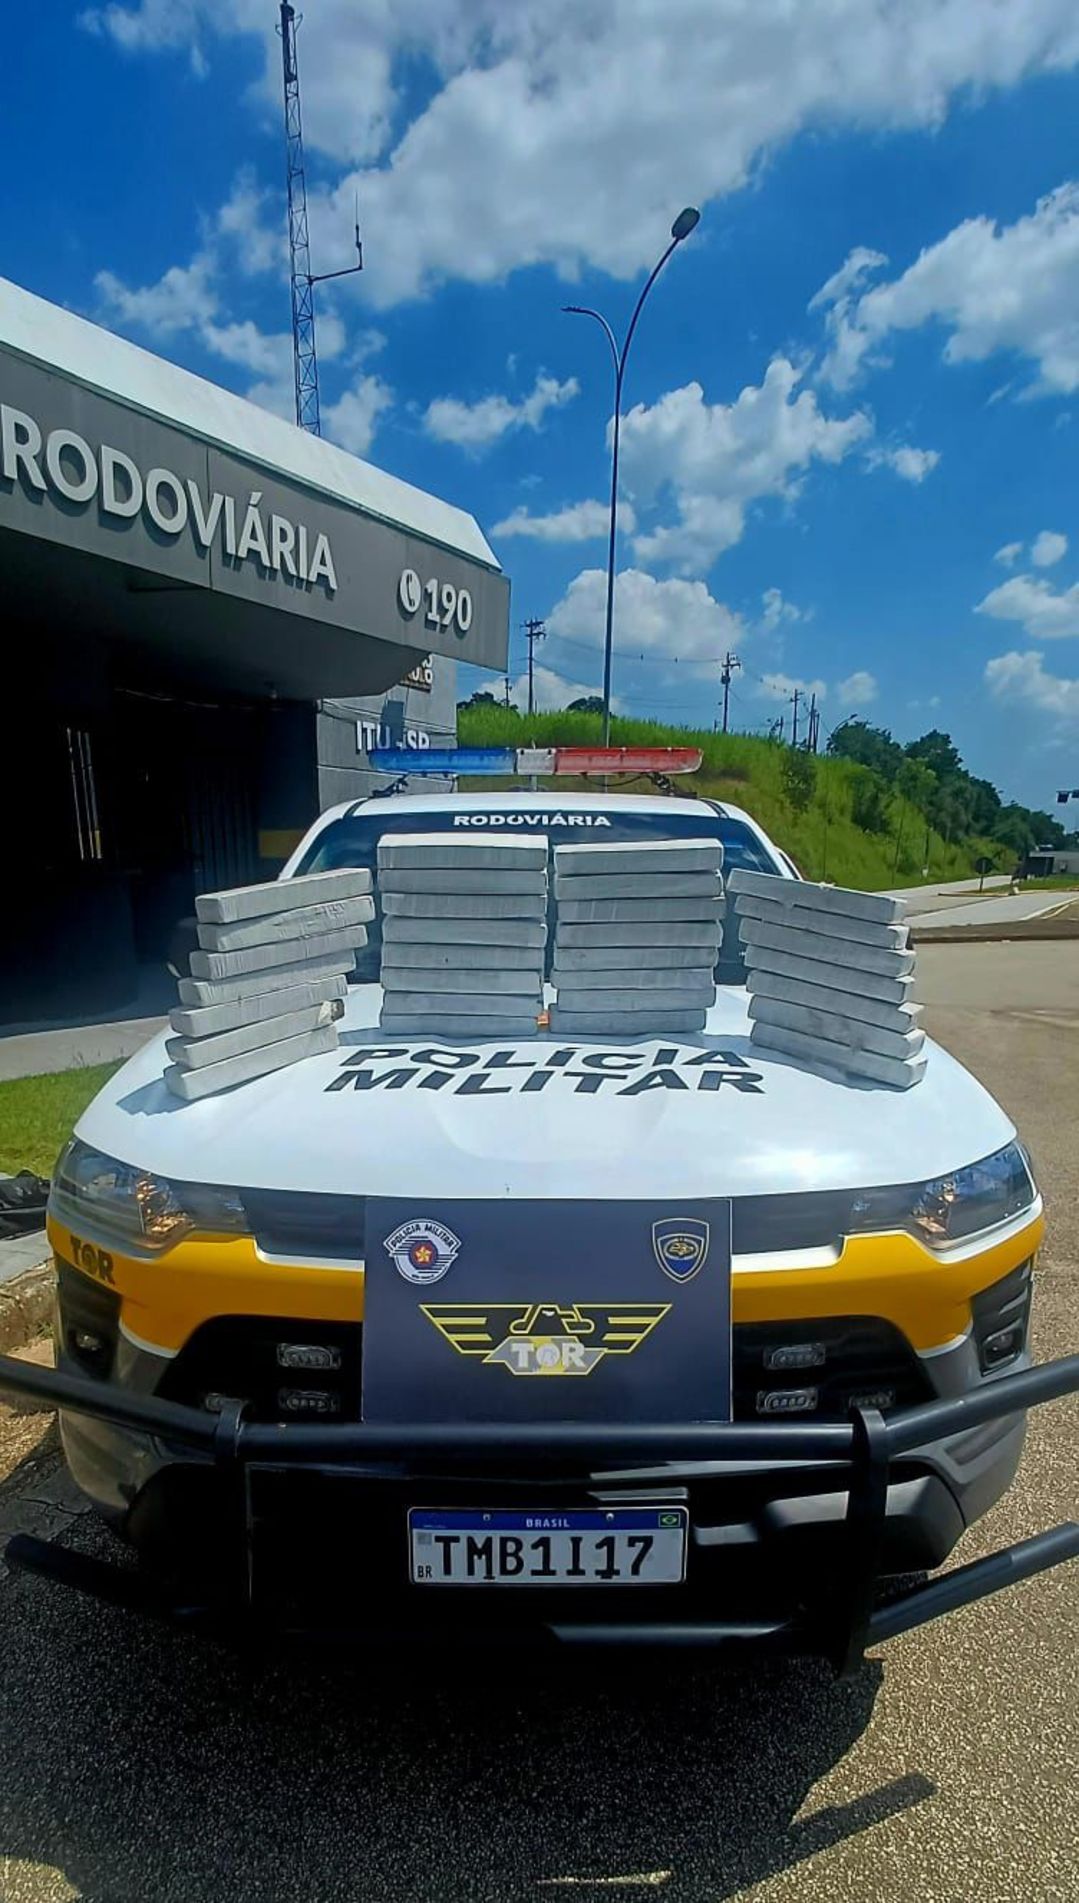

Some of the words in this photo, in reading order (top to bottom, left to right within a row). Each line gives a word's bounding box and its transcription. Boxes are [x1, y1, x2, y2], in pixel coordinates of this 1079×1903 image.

[0, 404, 338, 591] RODOVIÁRIA
[425, 578, 471, 632] 190
[357, 720, 390, 751] ITU
[453, 812, 611, 827] RODOVIÁRIA
[340, 1047, 751, 1069] POLÍCIA
[324, 1068, 766, 1095] MILITAR
[425, 1224, 455, 1248] MILITAR
[70, 1234, 116, 1286] TOR
[510, 1342, 586, 1369] TOR
[526, 1518, 570, 1528] BRASIL
[434, 1535, 654, 1577] TMB1I17
[417, 1565, 433, 1578] BR
